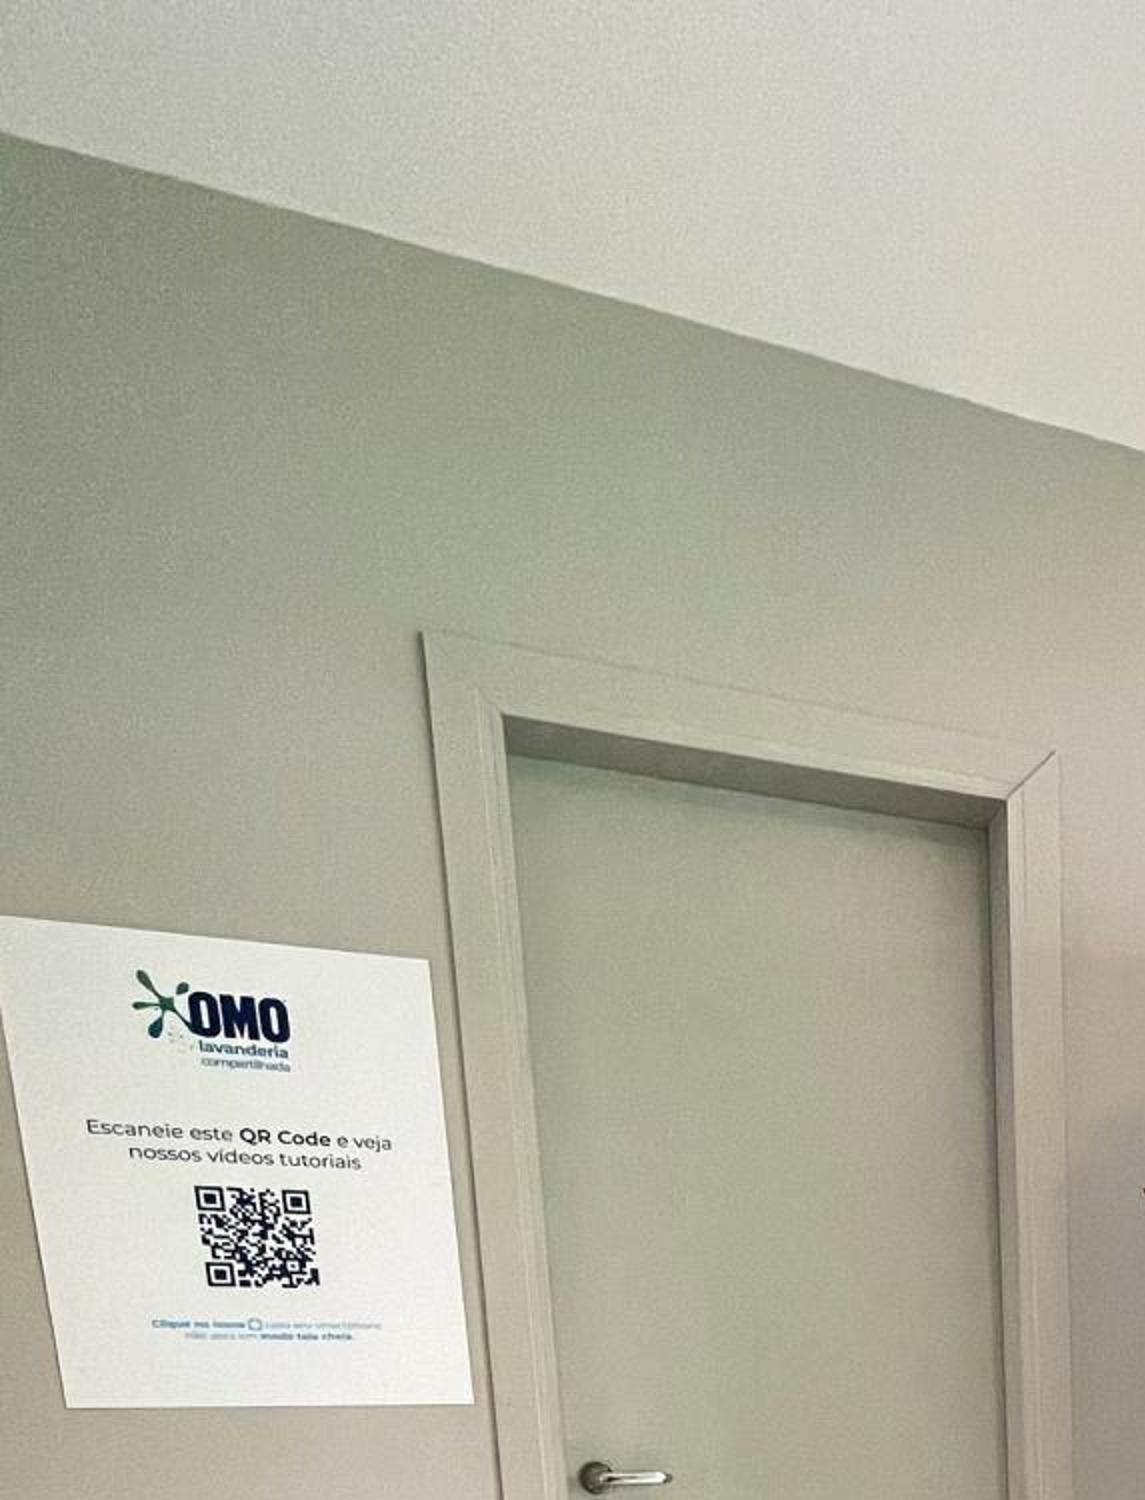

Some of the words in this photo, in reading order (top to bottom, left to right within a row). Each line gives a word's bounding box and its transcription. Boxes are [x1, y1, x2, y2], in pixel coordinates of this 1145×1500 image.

[188, 991, 290, 1043] OMO
[198, 1040, 289, 1058] lavanderia
[201, 1057, 290, 1072] compartilhada
[86, 1118, 184, 1139] Escaneie
[189, 1127, 233, 1141] este
[239, 1127, 272, 1146] QR
[277, 1130, 331, 1147] Code
[337, 1135, 349, 1148] e
[353, 1135, 392, 1152] veja
[128, 1147, 202, 1162] nossos
[279, 1152, 362, 1170] tutoriais
